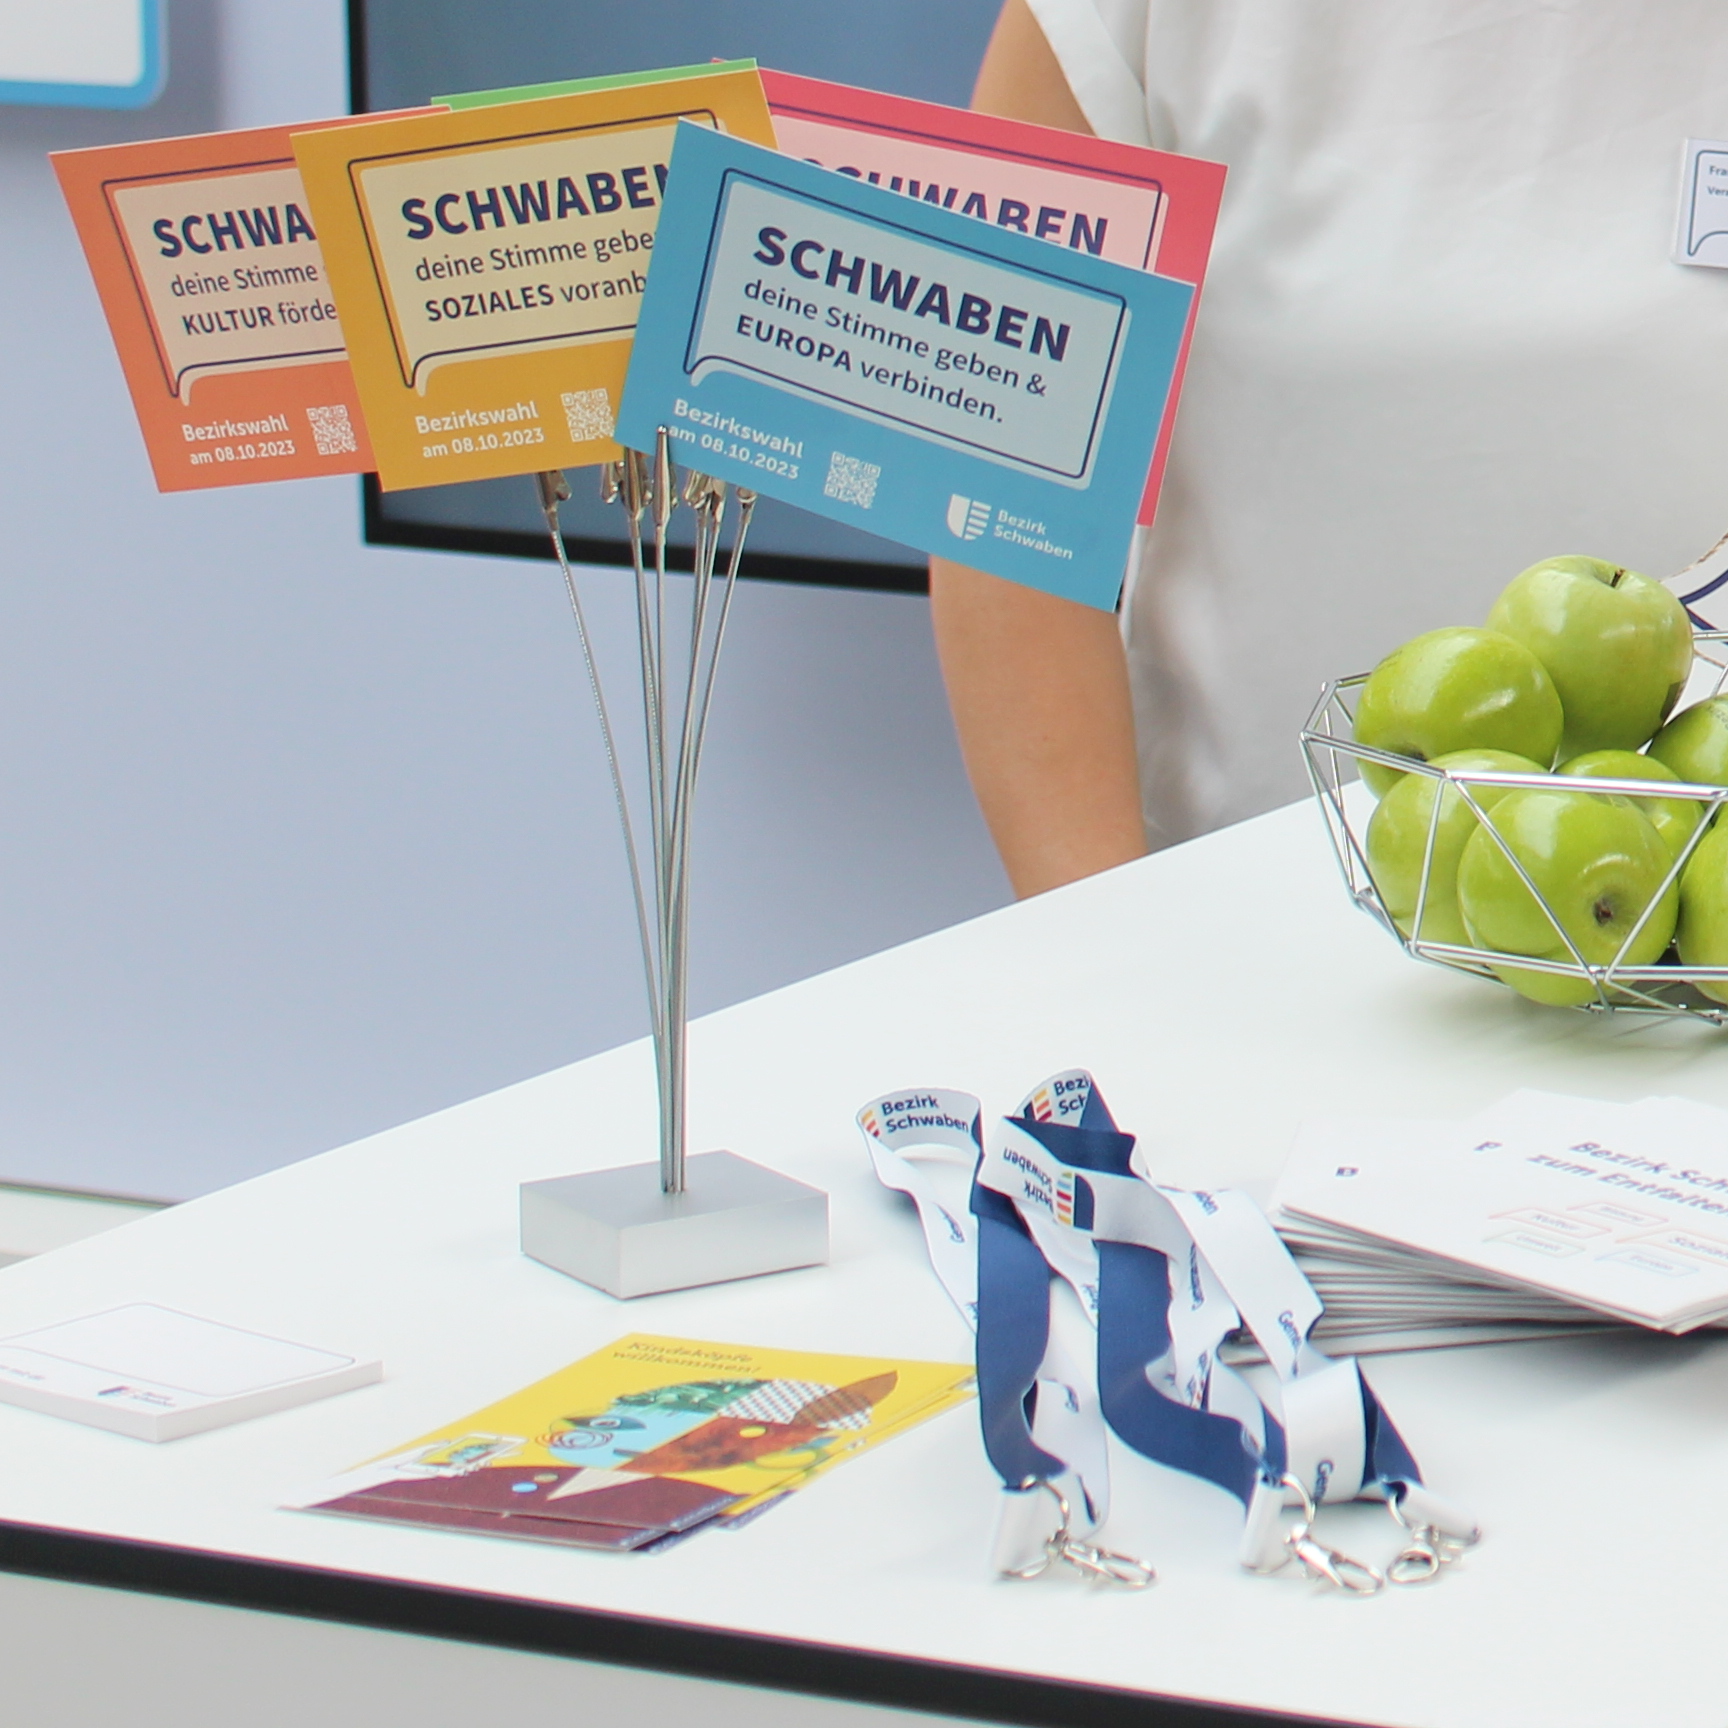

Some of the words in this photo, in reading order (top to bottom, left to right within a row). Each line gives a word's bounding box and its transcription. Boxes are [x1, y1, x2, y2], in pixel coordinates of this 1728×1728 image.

[153, 203, 317, 258] SCHWA
[415, 255, 485, 282] deine
[490, 241, 587, 271] Stimme
[593, 229, 656, 262] gebe
[171, 272, 231, 297] deine
[233, 264, 319, 290] Stimme
[752, 226, 1071, 362] SCHWABEN
[182, 306, 275, 335] KULTUR
[278, 298, 338, 325] förde
[425, 284, 554, 321] SOZIALES
[744, 279, 818, 320] deine
[824, 306, 930, 358] Stimme
[934, 346, 1019, 389] geben
[1026, 373, 1048, 398] &
[736, 314, 852, 372] EUROPA
[860, 360, 1003, 423] verbinden.
[181, 414, 290, 442] Bezirkswahl
[415, 400, 539, 434] Bezirkswahl
[673, 397, 804, 459] Bezirkswahl
[190, 452, 213, 465] am
[215, 440, 296, 463] 08.10.2023
[422, 443, 449, 458] am
[451, 427, 545, 453] 08.10.2023
[668, 425, 696, 444] am
[701, 433, 800, 480] 08.10.2023
[997, 509, 1047, 536] Bezirk
[993, 524, 1074, 560] Schwaben
[881, 1094, 941, 1117] Bezirk
[885, 1113, 970, 1134] Schwaben
[1525, 1153, 1598, 1177] zum
[1570, 1141, 1669, 1175] Bezirk
